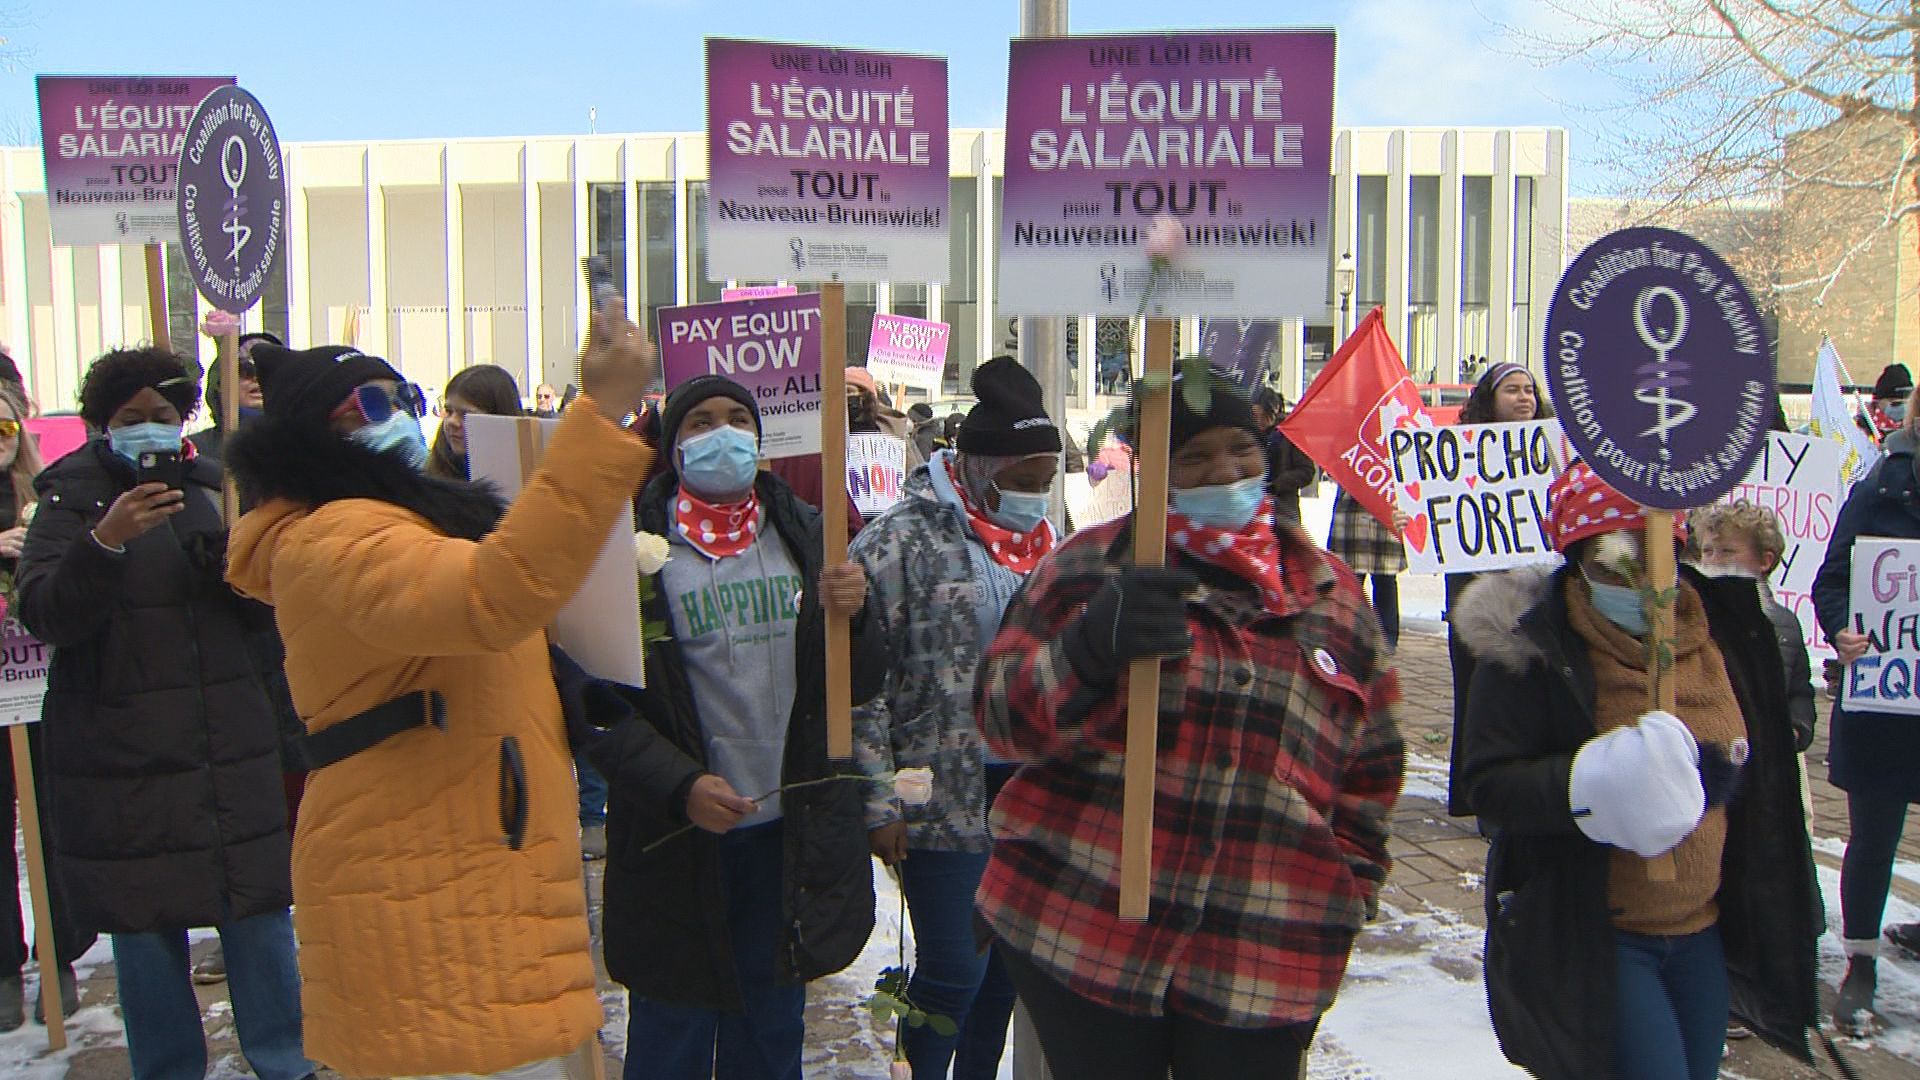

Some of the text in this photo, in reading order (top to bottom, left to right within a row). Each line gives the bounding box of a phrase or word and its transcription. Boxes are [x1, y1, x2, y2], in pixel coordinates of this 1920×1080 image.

[770, 52, 892, 80] UNE LOI SUR
[1089, 40, 1252, 68] UNE LOI SUR
[88, 82, 191, 96] UNE LOI SUR
[751, 76, 915, 128] L'ÉQUITÉ
[1061, 66, 1283, 124] L'ÉQUITÉ
[75, 99, 198, 130] L'ÉQUIT
[189, 98, 279, 180] Coalition for Pay Equity
[727, 121, 931, 166] SALARIALE
[1029, 125, 1304, 170] SALARIALE
[790, 170, 880, 202] TOUT
[1063, 200, 1103, 220] pour
[1104, 181, 1227, 217] TOUT
[719, 199, 941, 228] Nouveau-Brunswick!
[185, 183, 281, 302] Coalition pour l'équité salariale
[1014, 219, 1317, 248] Nouveau-unswick!
[1569, 241, 1761, 355] Coalition for Pay Equity
[671, 308, 821, 344] PAY EQUIT
[878, 319, 946, 340] PAY EQUITY
[889, 332, 931, 352] NOW
[707, 336, 802, 376] NOW
[918, 353, 937, 364] ALL
[757, 385, 779, 399] for
[1559, 330, 1603, 441] Coalition
[1594, 437, 1646, 482] pour
[1647, 453, 1722, 498] l'équité
[1716, 379, 1766, 471] salariale
[1340, 443, 1397, 505] ACOR
[1390, 426, 1550, 483] PRO-CHO
[1764, 437, 1810, 485] Y
[1849, 655, 1920, 700] EQ
